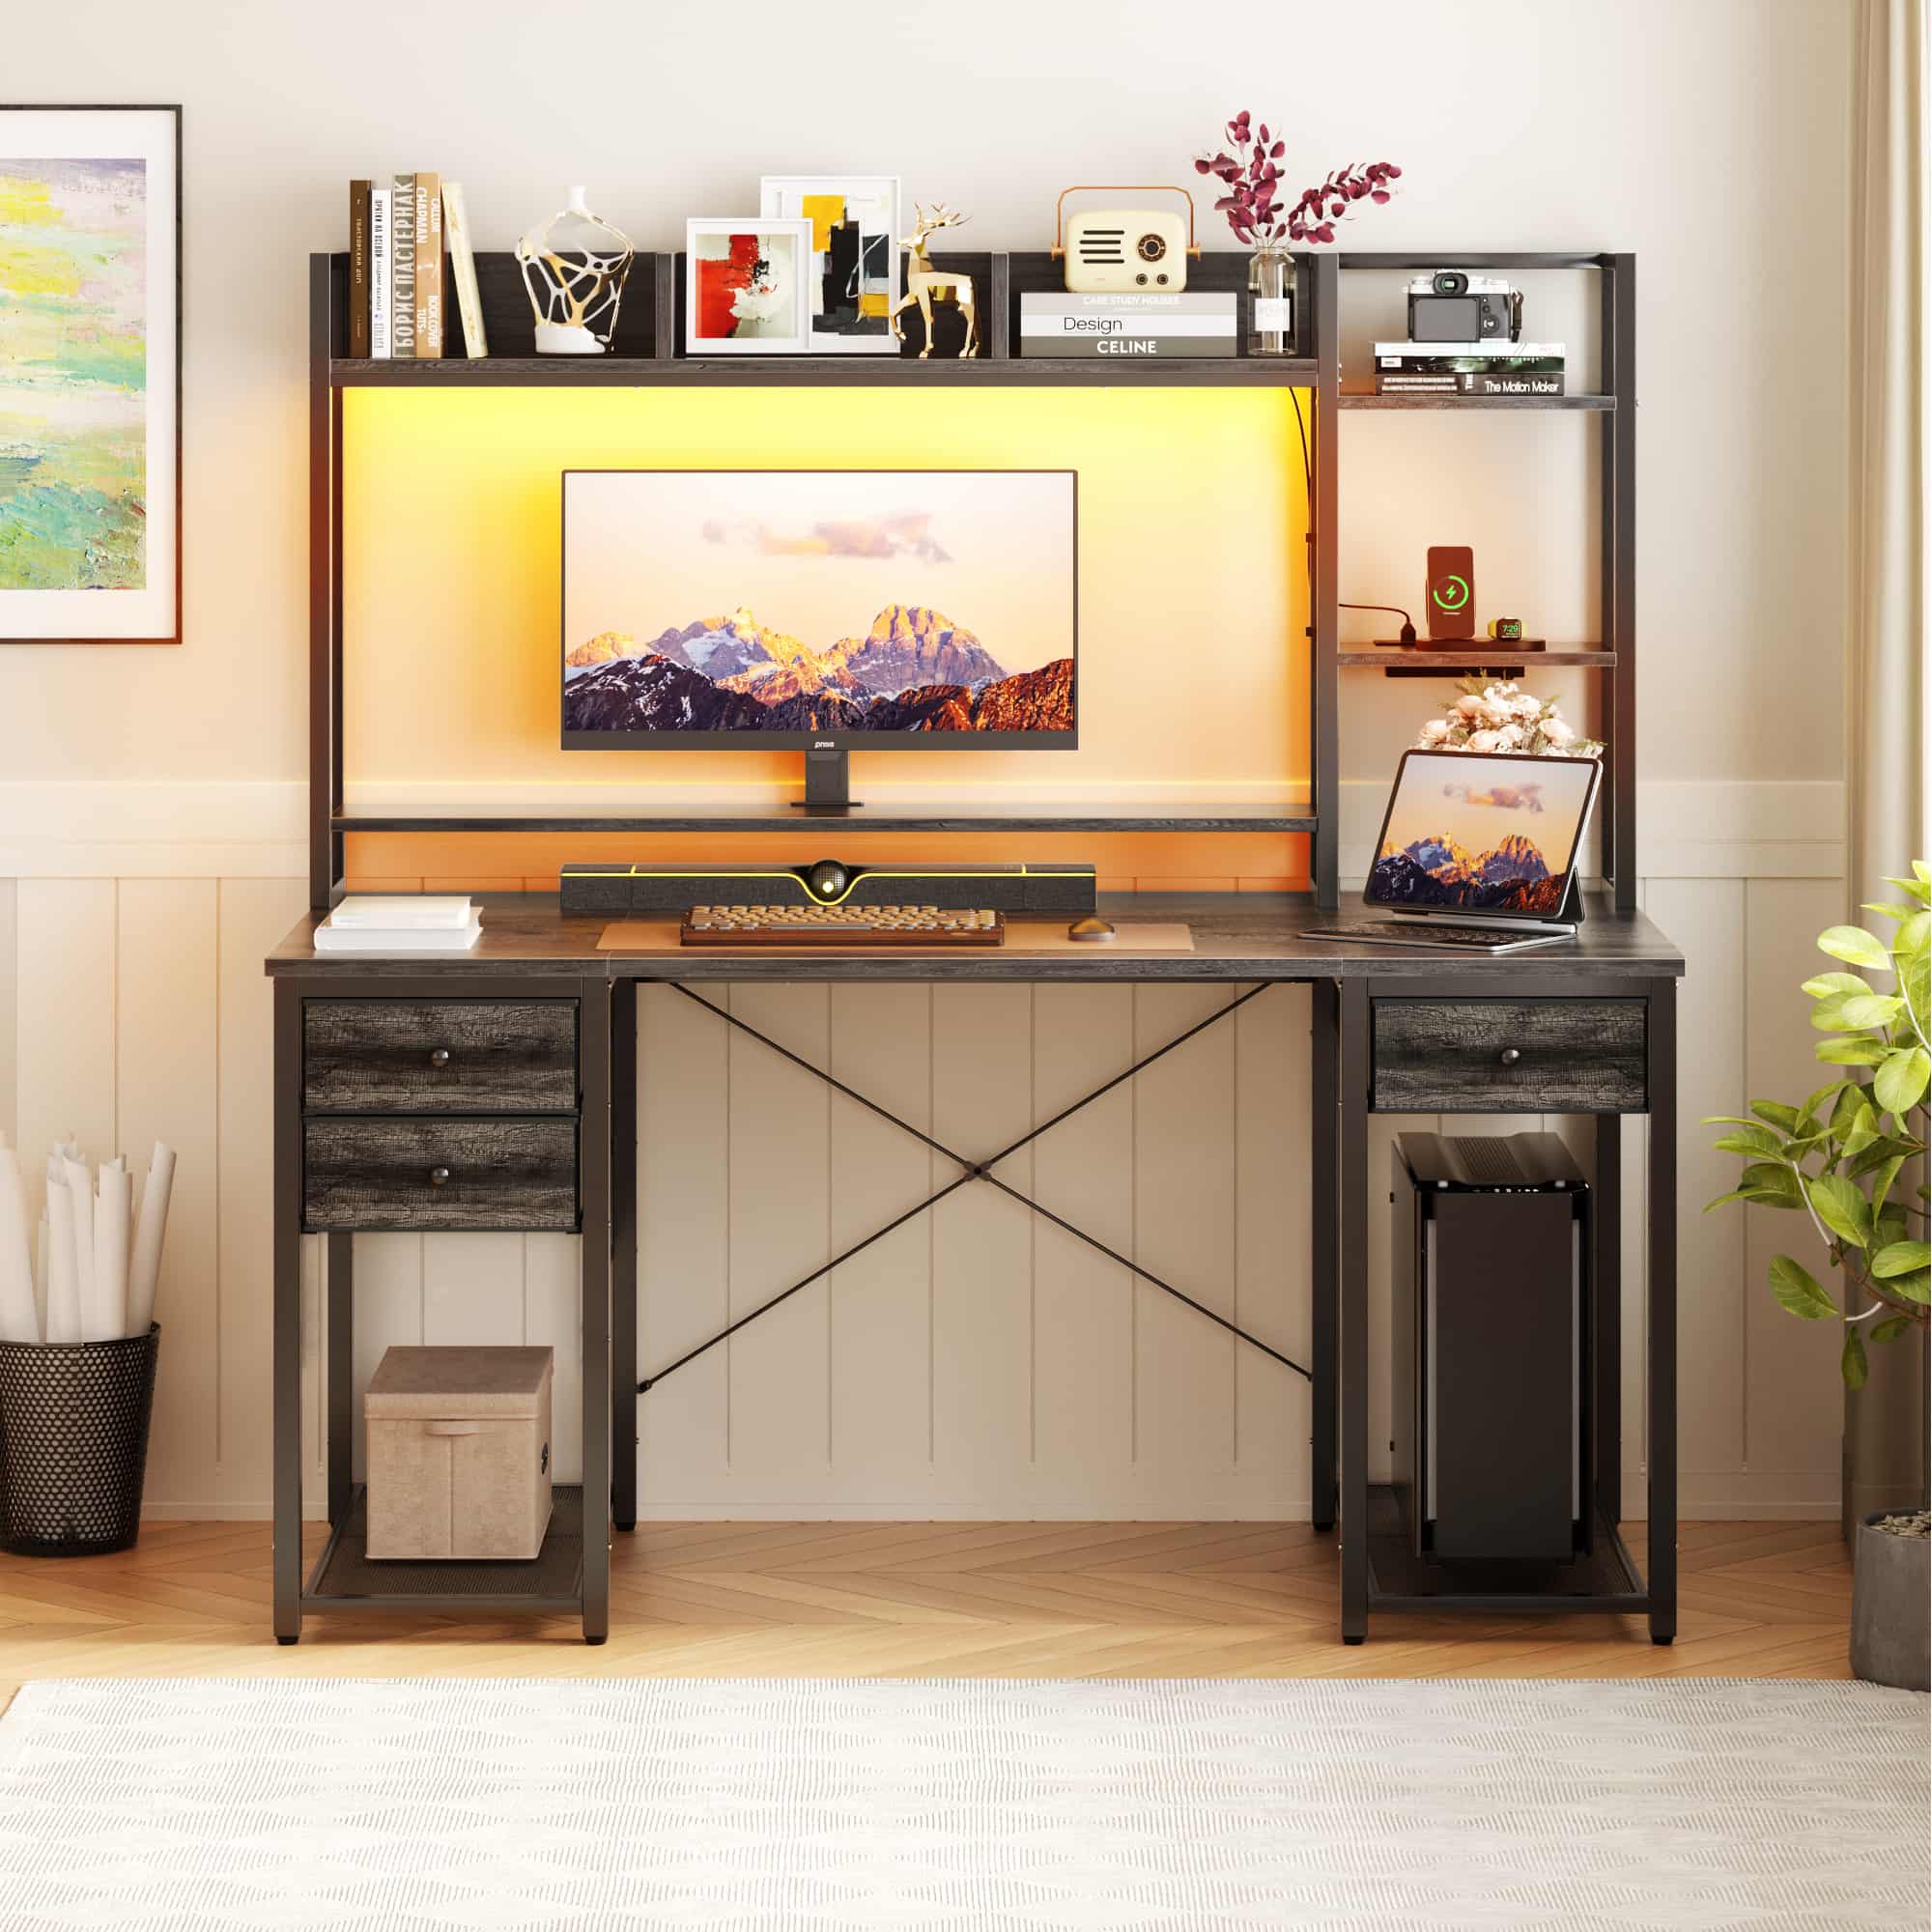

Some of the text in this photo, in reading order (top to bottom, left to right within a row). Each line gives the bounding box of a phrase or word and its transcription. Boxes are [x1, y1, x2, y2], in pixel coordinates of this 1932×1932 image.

[416, 186, 428, 243] CHAPMAN
[1064, 317, 1122, 335] Design
[1096, 340, 1157, 355] CELINE
[1485, 381, 1501, 393] The
[1502, 381, 1531, 393] Motion
[1532, 381, 1559, 393] Maker
